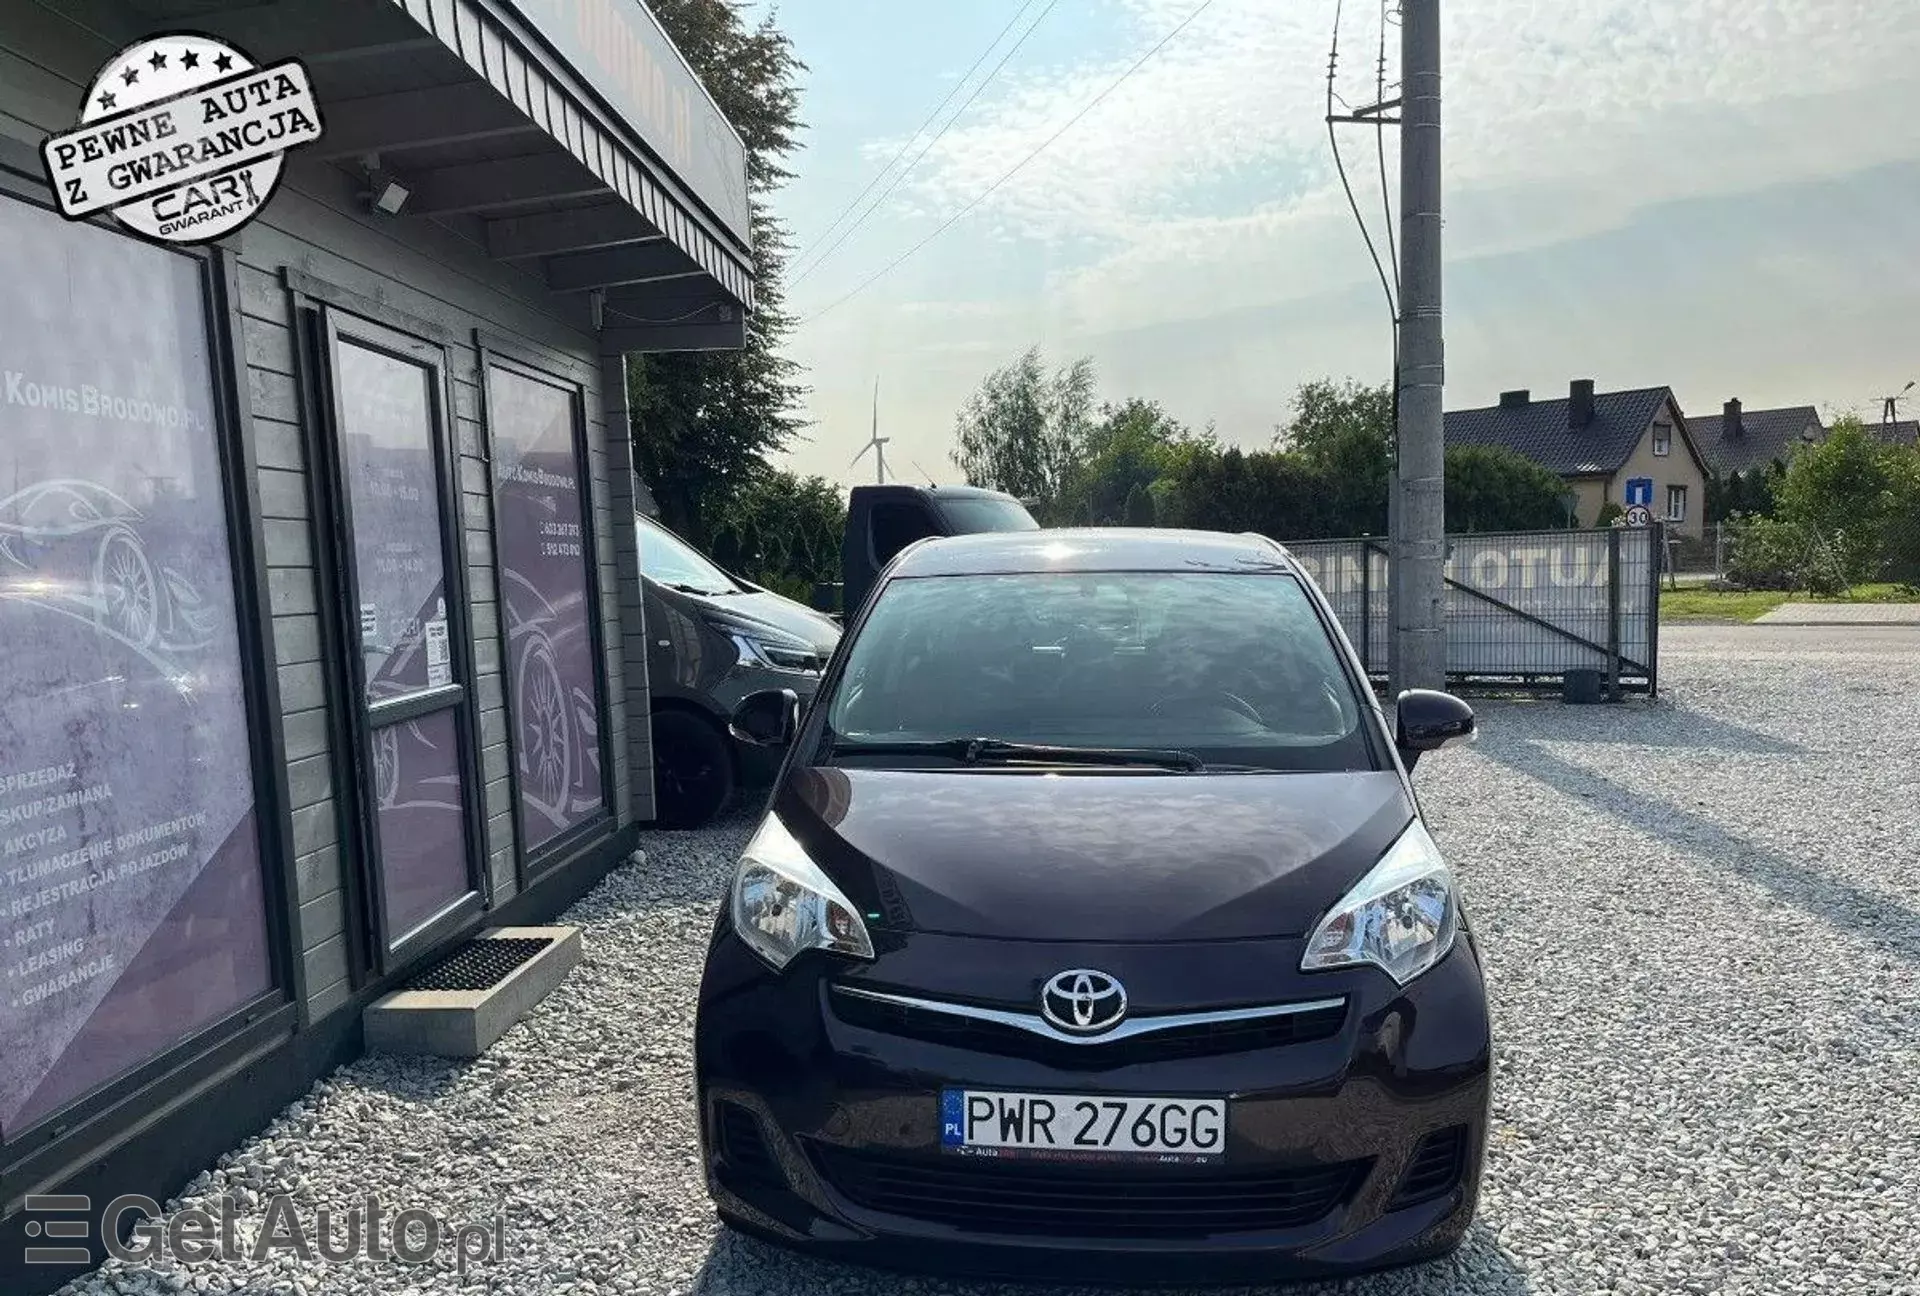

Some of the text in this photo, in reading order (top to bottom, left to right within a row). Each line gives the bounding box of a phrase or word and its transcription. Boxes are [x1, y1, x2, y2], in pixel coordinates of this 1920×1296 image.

[1629, 511, 1648, 525] 30
[4, 825, 67, 857] AKCYZA
[11, 868, 116, 917] REJESTRACJA
[15, 918, 55, 948] RATY
[18, 937, 85, 977] LEASING
[22, 953, 115, 1006] GWARANCJE
[945, 1123, 961, 1136] PL
[968, 1096, 1219, 1149] PWR 276GG
